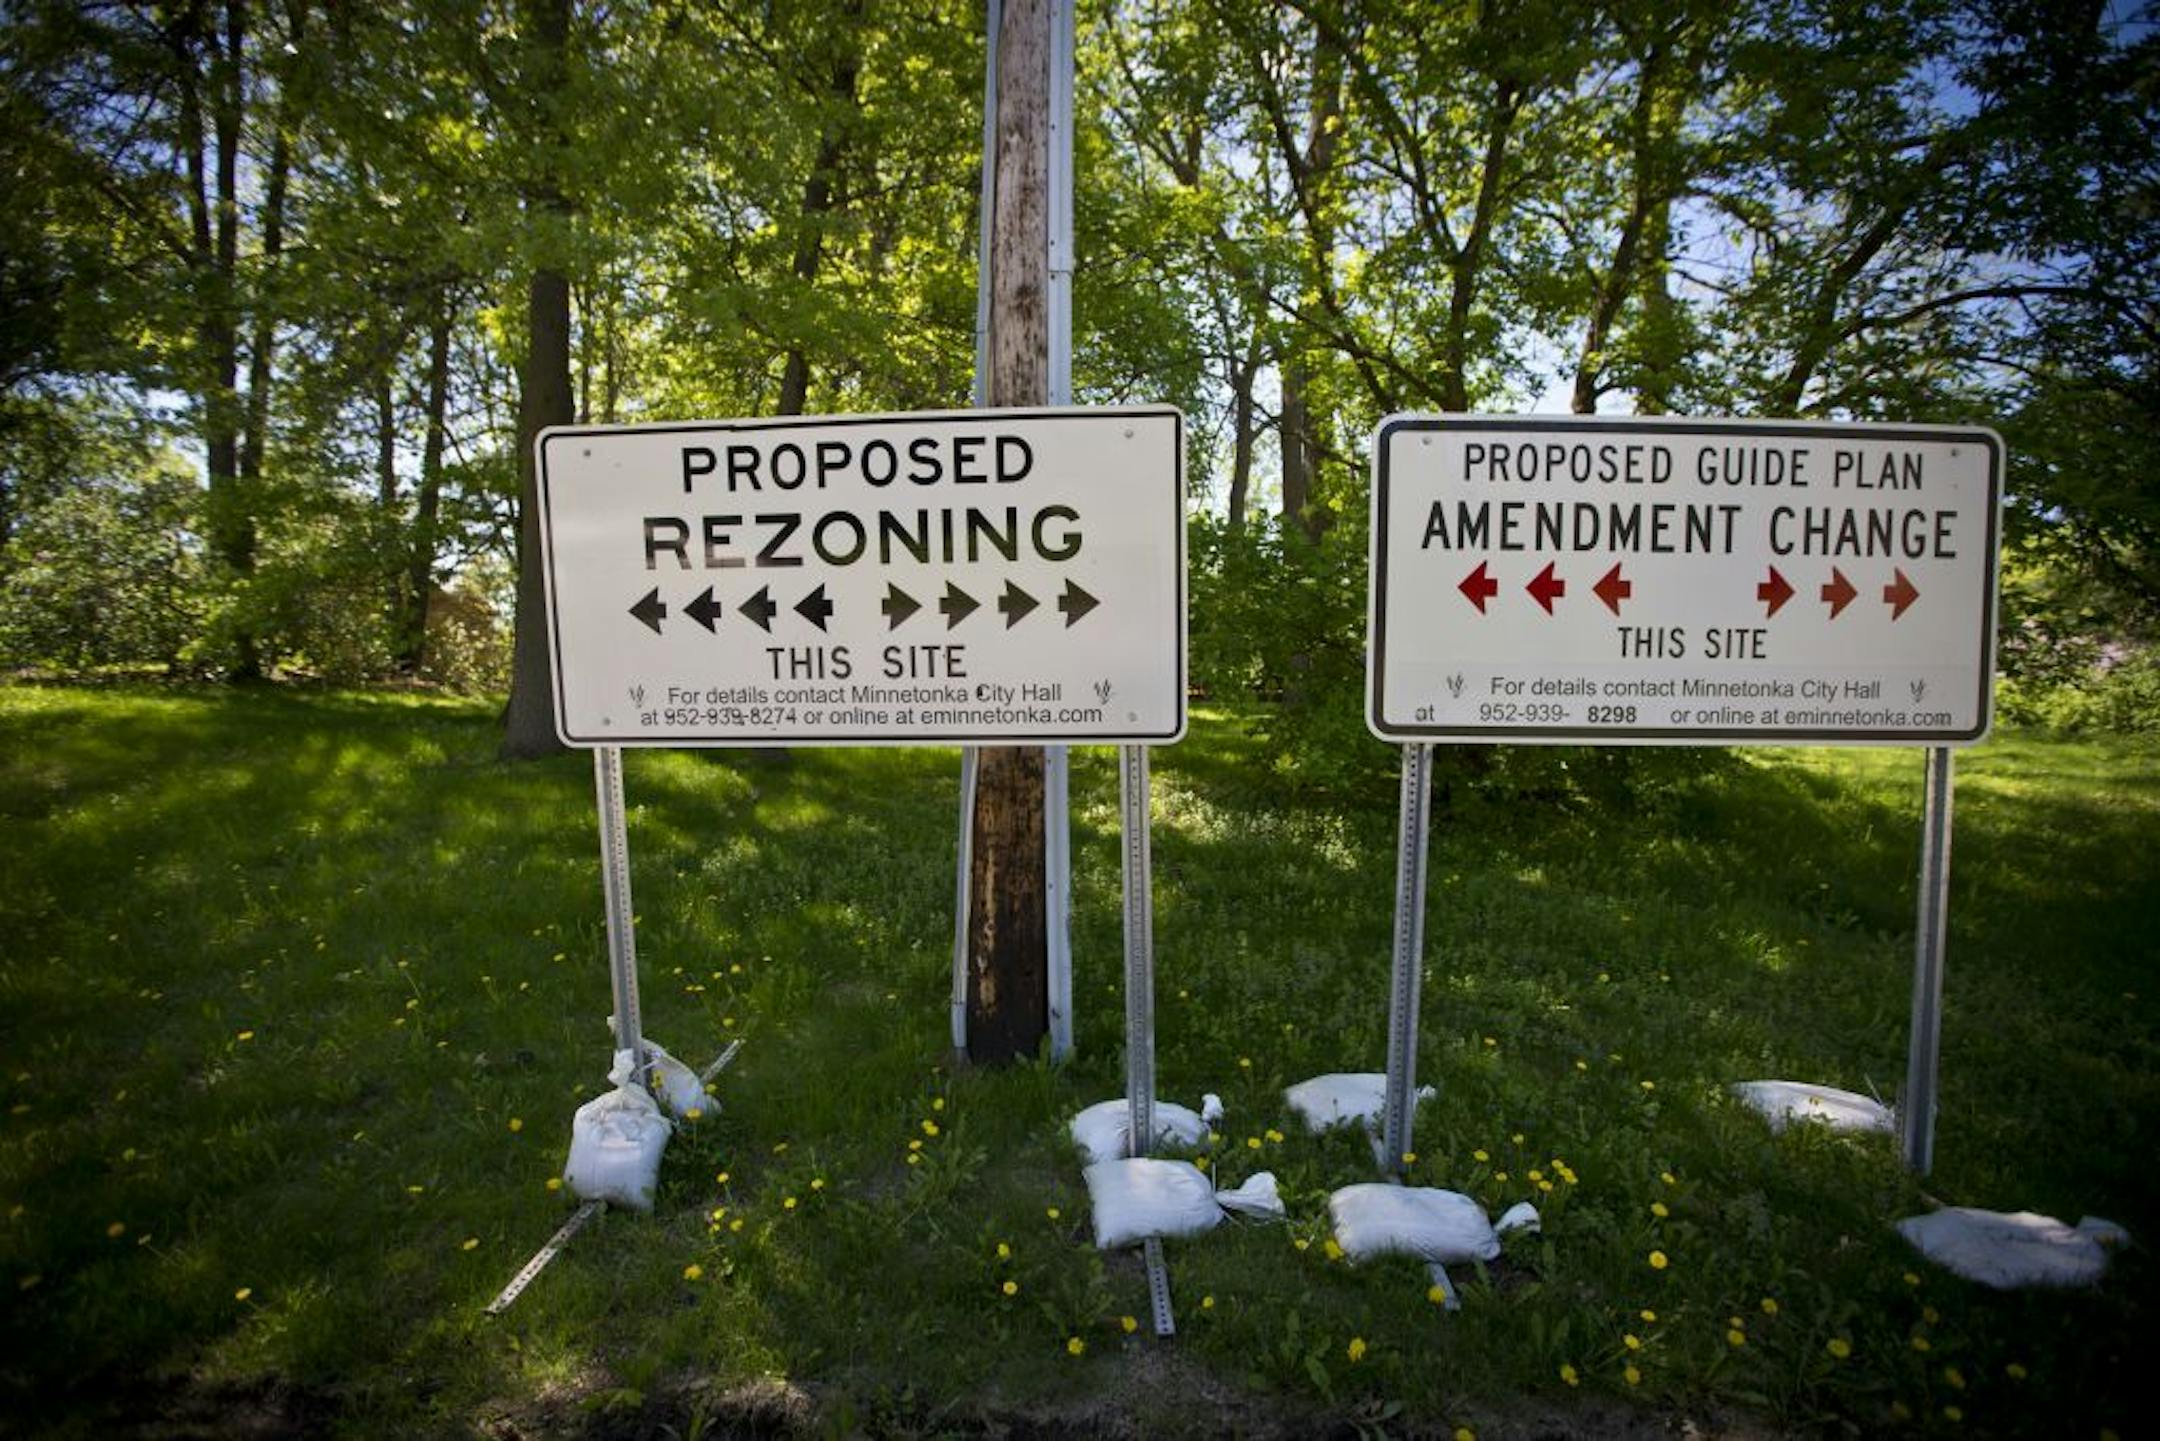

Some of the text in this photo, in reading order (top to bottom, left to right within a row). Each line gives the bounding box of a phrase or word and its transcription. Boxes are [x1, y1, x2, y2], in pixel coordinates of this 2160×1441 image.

[682, 435, 1034, 494] PROPOSED
[1464, 443, 1924, 490] PROPOSED GUIDE PLAN
[643, 504, 1083, 570] REZONING
[1421, 500, 1958, 559] AMENDMENT CHANGE
[1617, 626, 1768, 659] THIS SITE
[765, 645, 967, 680] THIS SITE
[668, 683, 1062, 706] For details contact Minnetonka City Hall
[1491, 677, 1880, 703] For details contact Minnetonka City Hall
[641, 705, 1102, 726] at 952-939-8274 or online at eminnetonka.com
[1415, 703, 1951, 727] at 952-939- 8298 or online at eminnetonka.com
